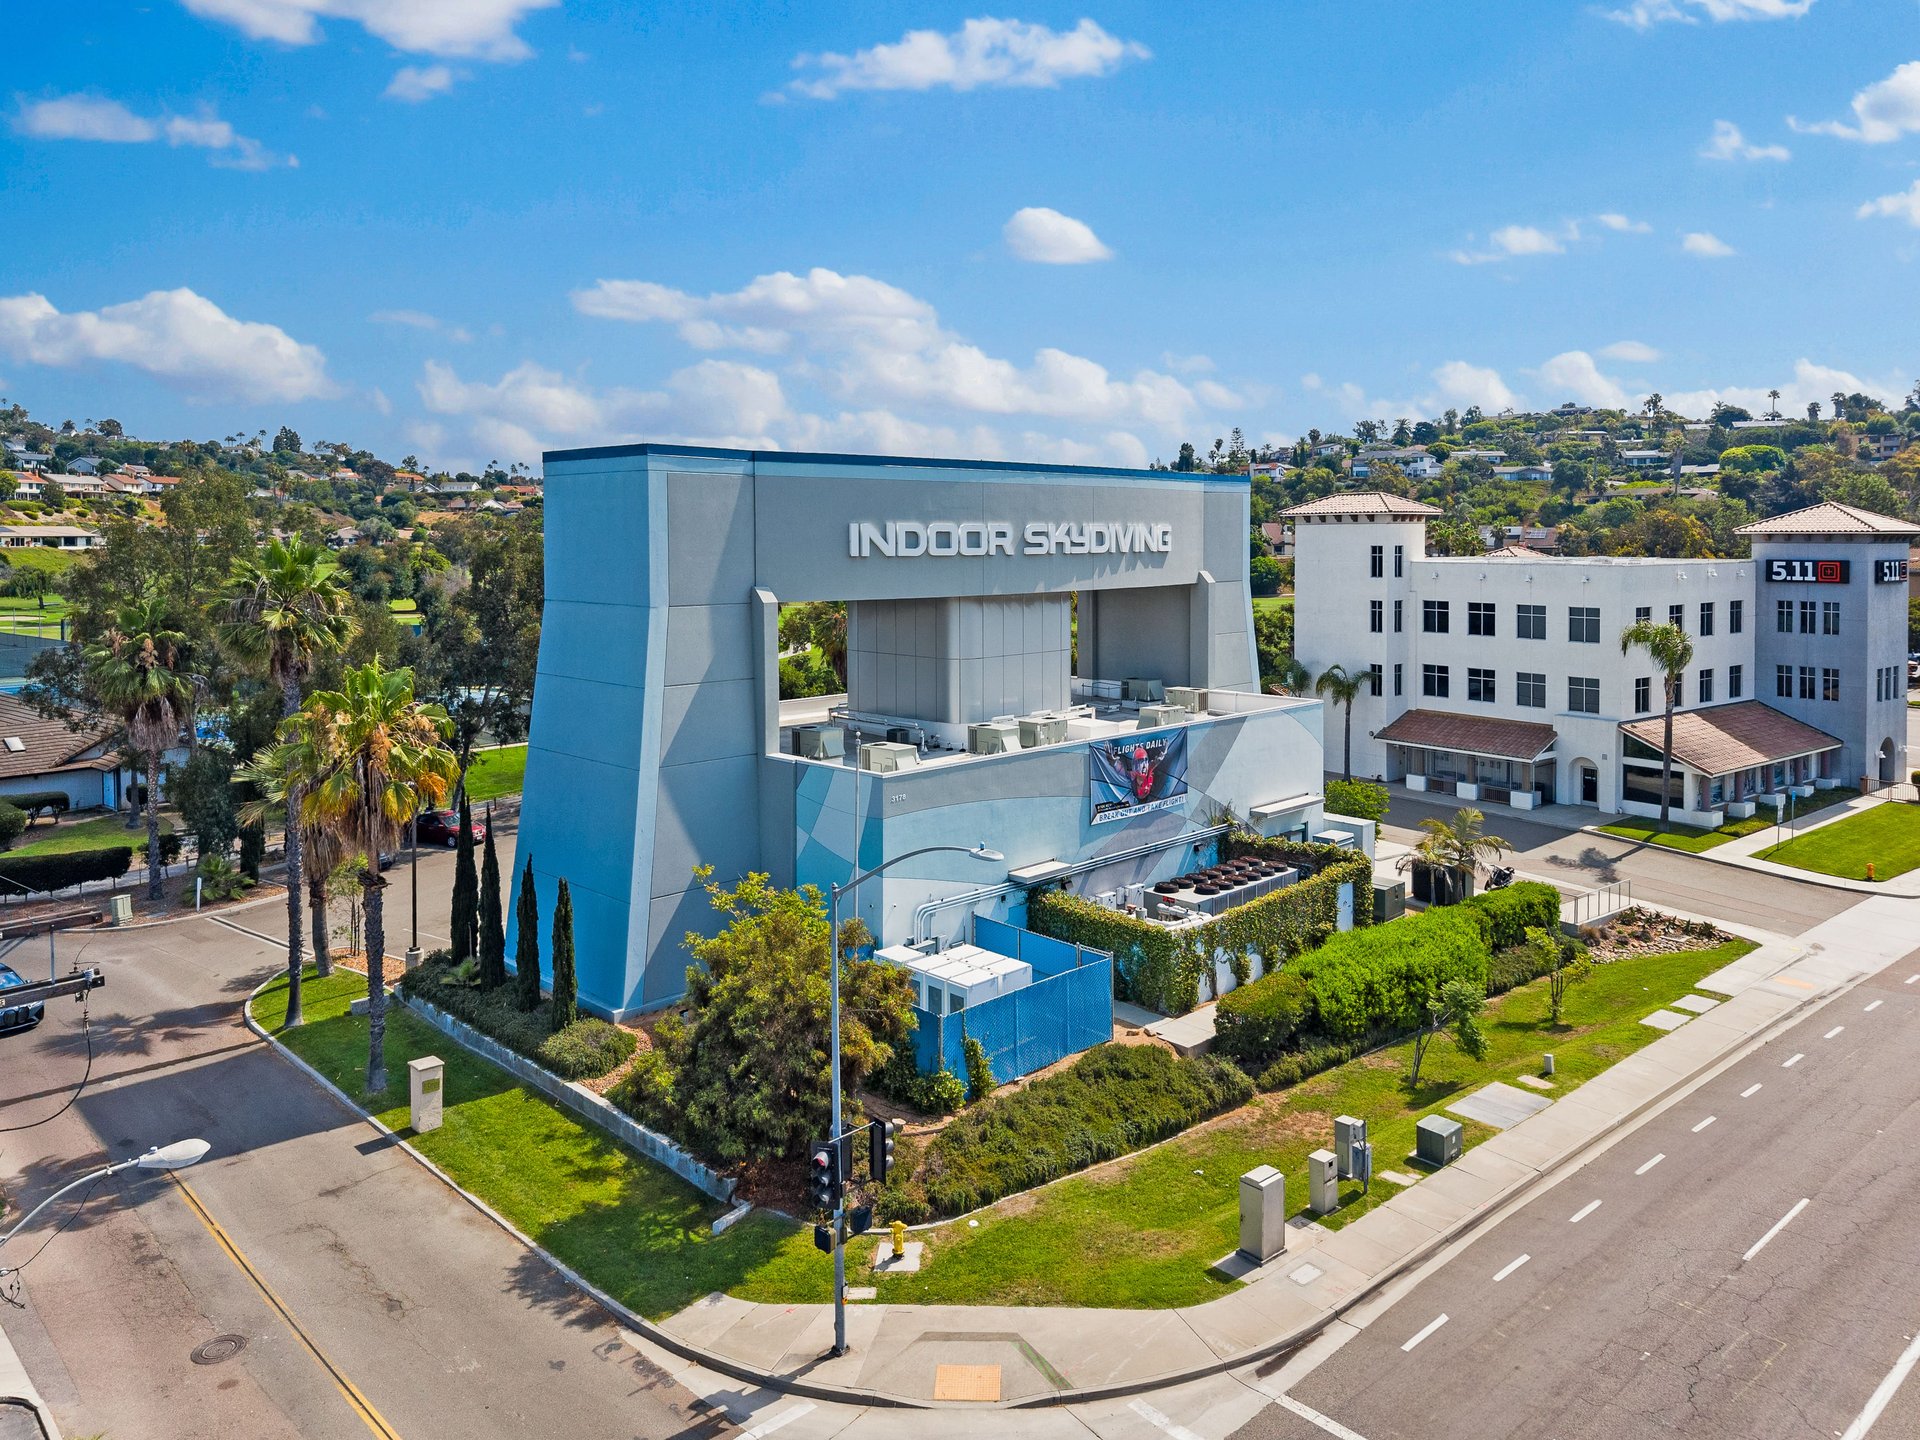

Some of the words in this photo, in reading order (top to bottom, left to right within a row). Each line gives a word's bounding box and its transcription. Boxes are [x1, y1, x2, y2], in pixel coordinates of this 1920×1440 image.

[849, 522, 1014, 557] INDOOR
[1023, 523, 1172, 555] SKYDIVING
[1771, 561, 1816, 581] 5.11
[1883, 561, 1899, 581] 5.11
[1113, 742, 1144, 755] FLIGHTS
[1146, 738, 1168, 749] DAILY
[891, 793, 907, 802] 3178
[1100, 811, 1119, 821] BREAK
